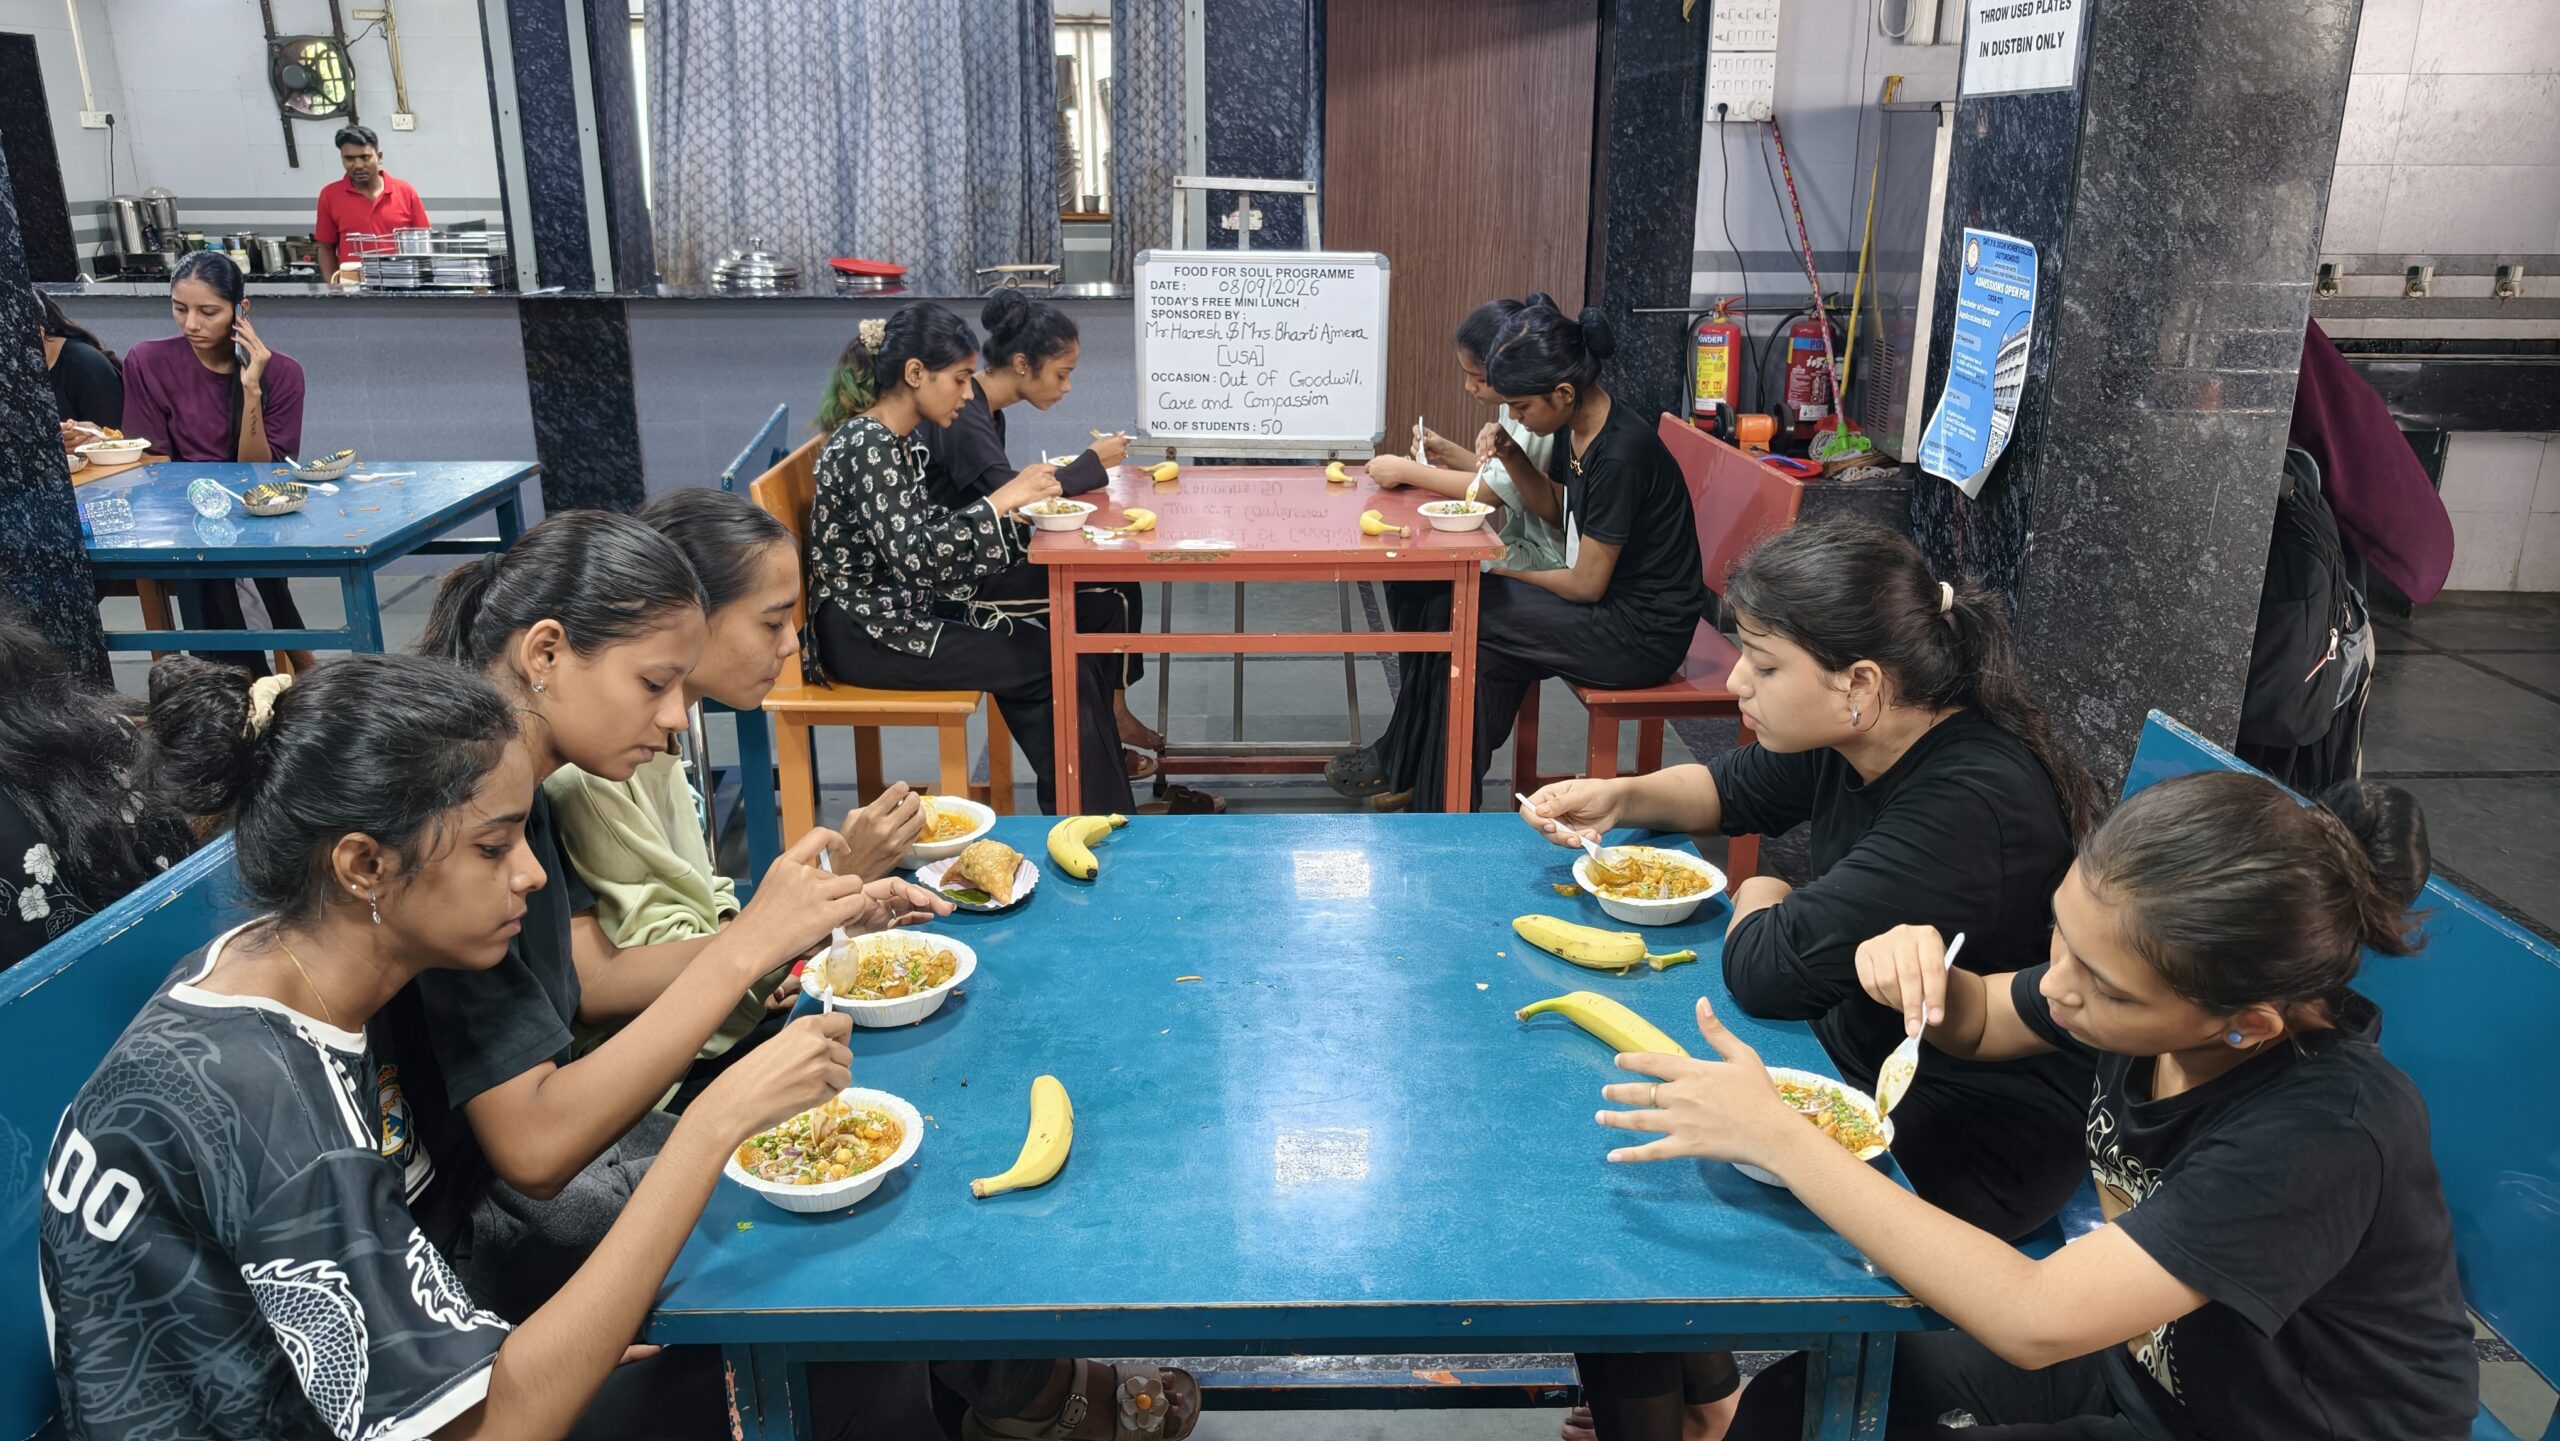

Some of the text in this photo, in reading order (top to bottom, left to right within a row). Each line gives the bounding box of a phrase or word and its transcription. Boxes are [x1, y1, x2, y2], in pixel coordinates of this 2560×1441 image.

[1980, 0, 2072, 24] THROW USED PLATES
[1979, 31, 2065, 57] IN DUSTBIN ONLY
[1174, 266, 1355, 279] FOOD FOR SOUL PROGRAMME
[1150, 281, 1179, 291] DATE
[1219, 278, 1321, 299] 08/09/2026
[1151, 296, 1300, 308] TODAY'S FREE MINI LUNCH
[1151, 309, 1222, 320] SPONSORED
[1225, 310, 1240, 320] BY
[1697, 336, 1723, 344] OWDER
[1217, 344, 1265, 367] [USA]
[1151, 373, 1210, 383] OCCASION
[1220, 371, 1249, 388] Out
[1159, 391, 1329, 415] Care and Compassion
[1151, 421, 1171, 431] NO.
[1173, 421, 1189, 431] OF
[1191, 421, 1250, 432] STUDENTS
[1260, 419, 1283, 435] 50
[44, 1128, 144, 1241] DO
